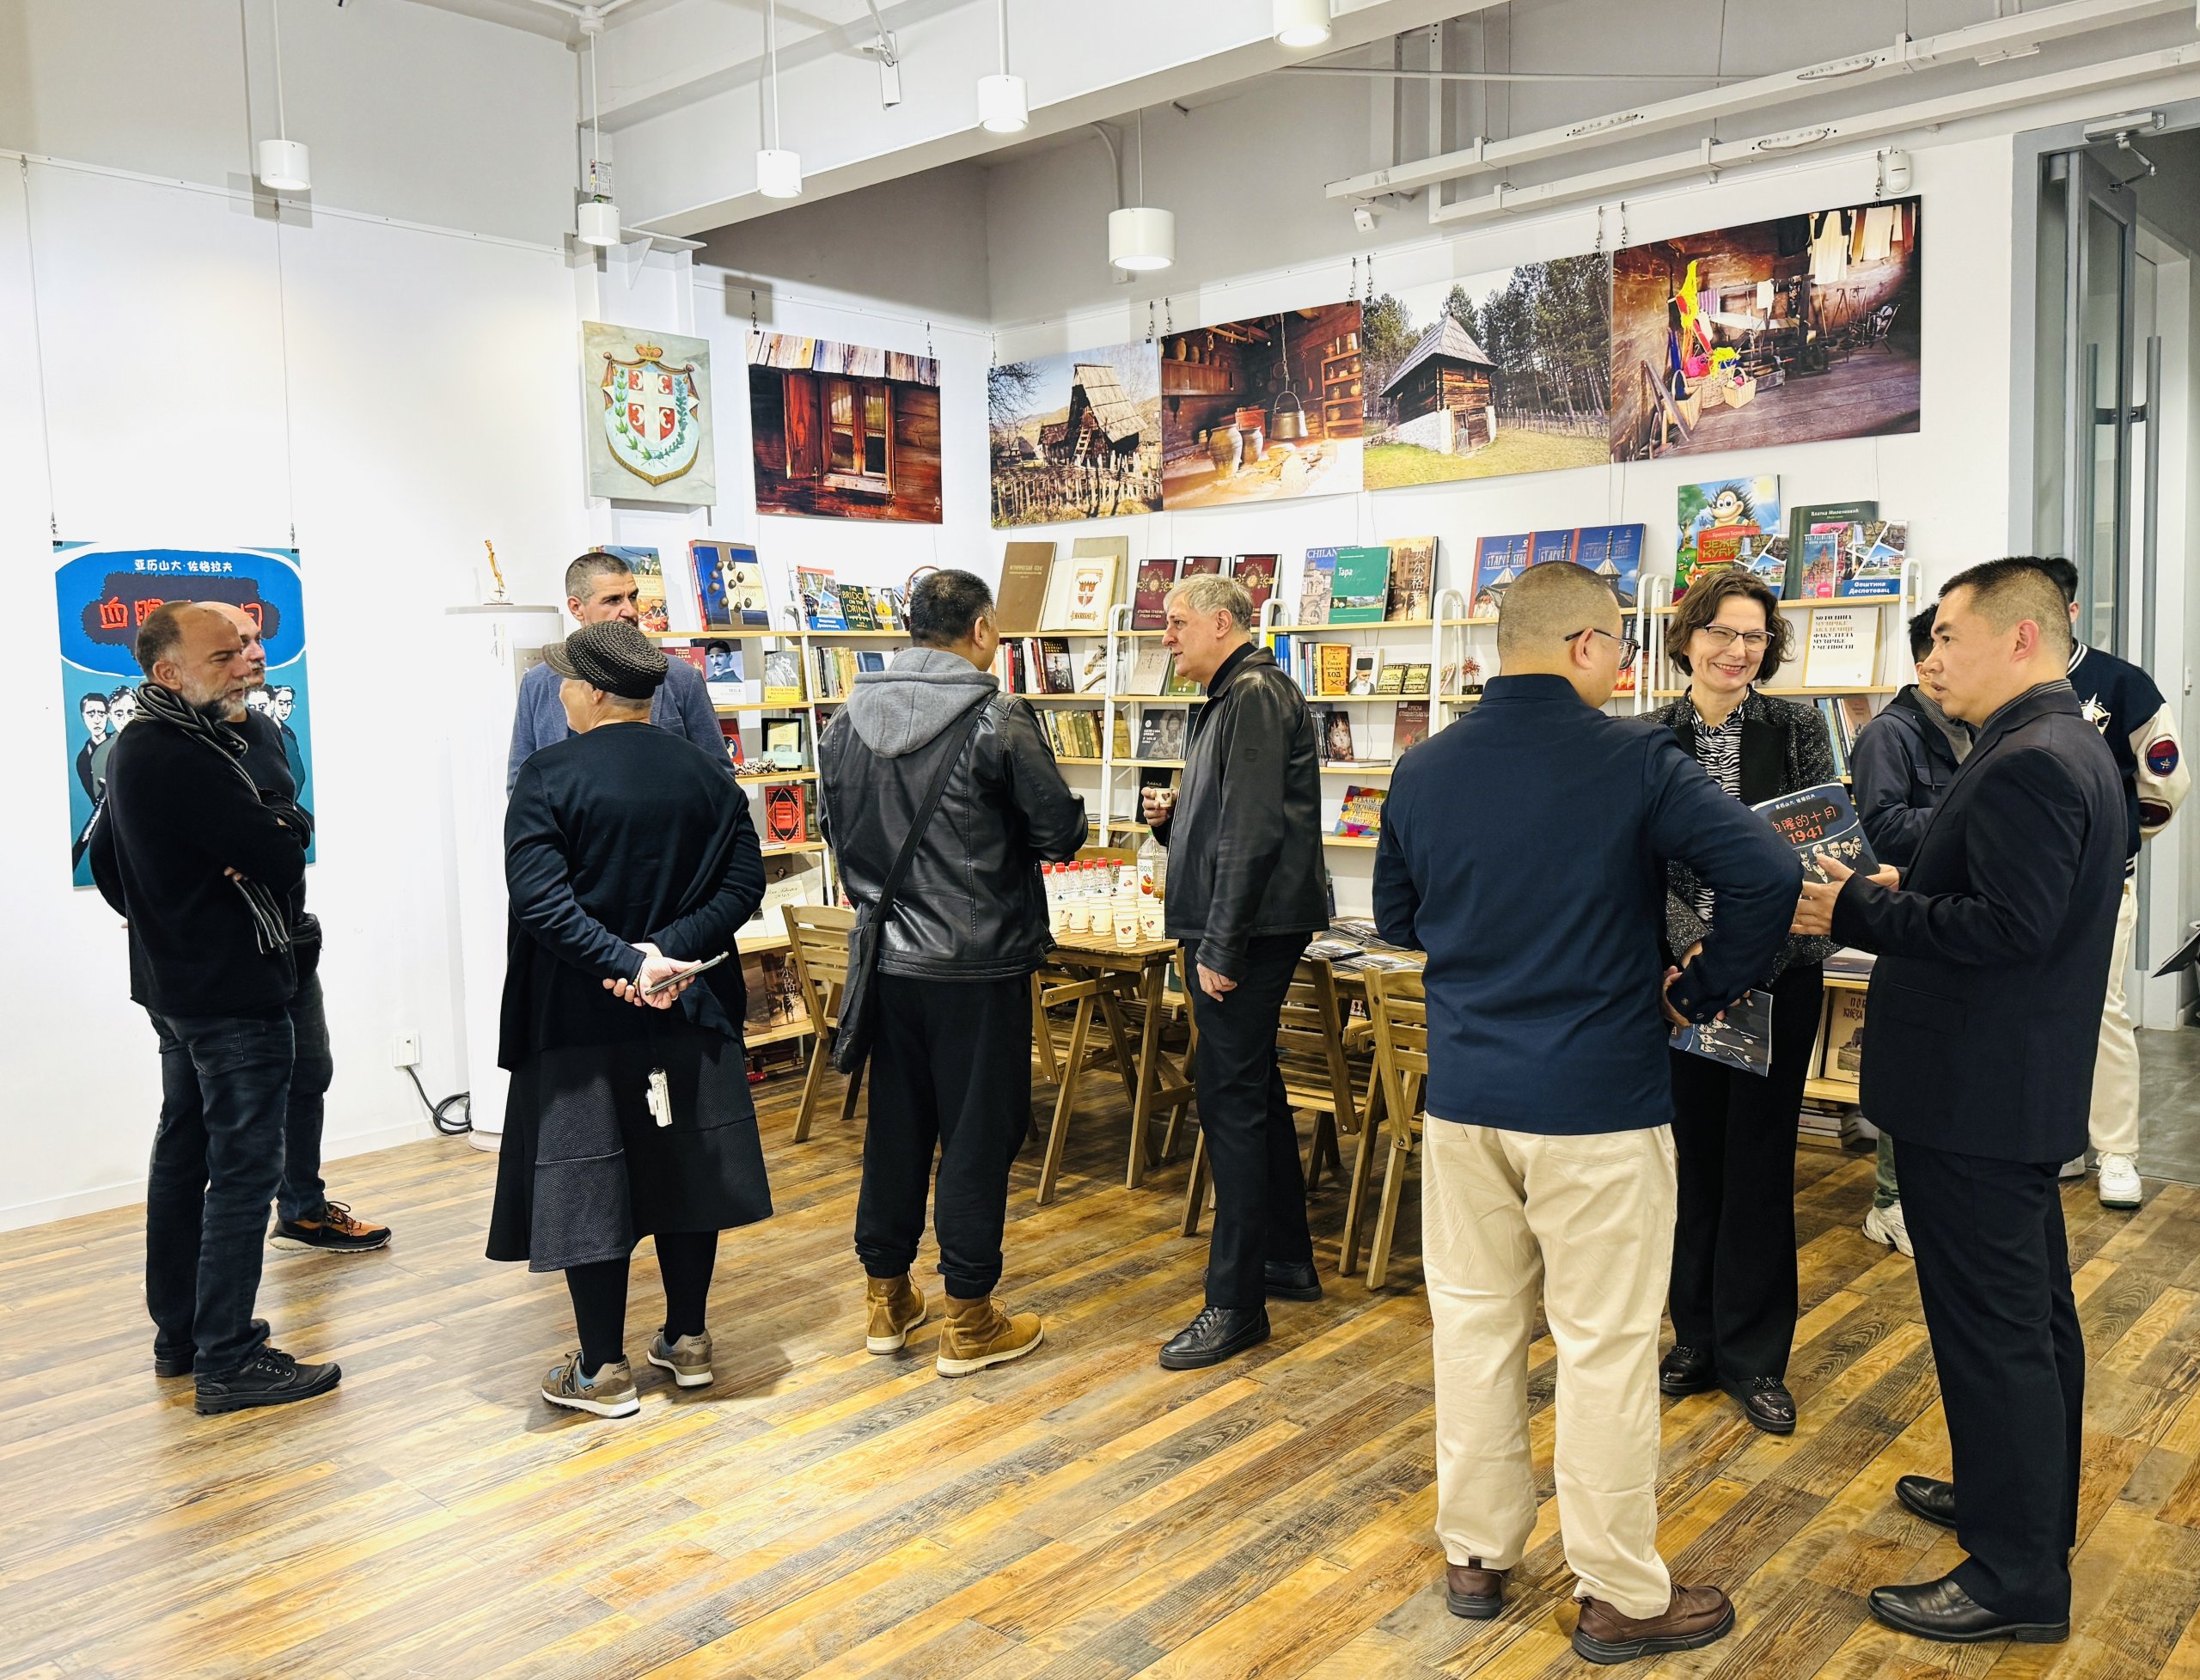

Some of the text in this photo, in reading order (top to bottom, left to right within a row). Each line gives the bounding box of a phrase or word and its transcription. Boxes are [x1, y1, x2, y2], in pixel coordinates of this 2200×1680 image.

[134, 559, 233, 573] 亚历山大·佐格拉夫
[846, 604, 869, 614] DRINA
[1788, 825, 1823, 844] 1941
